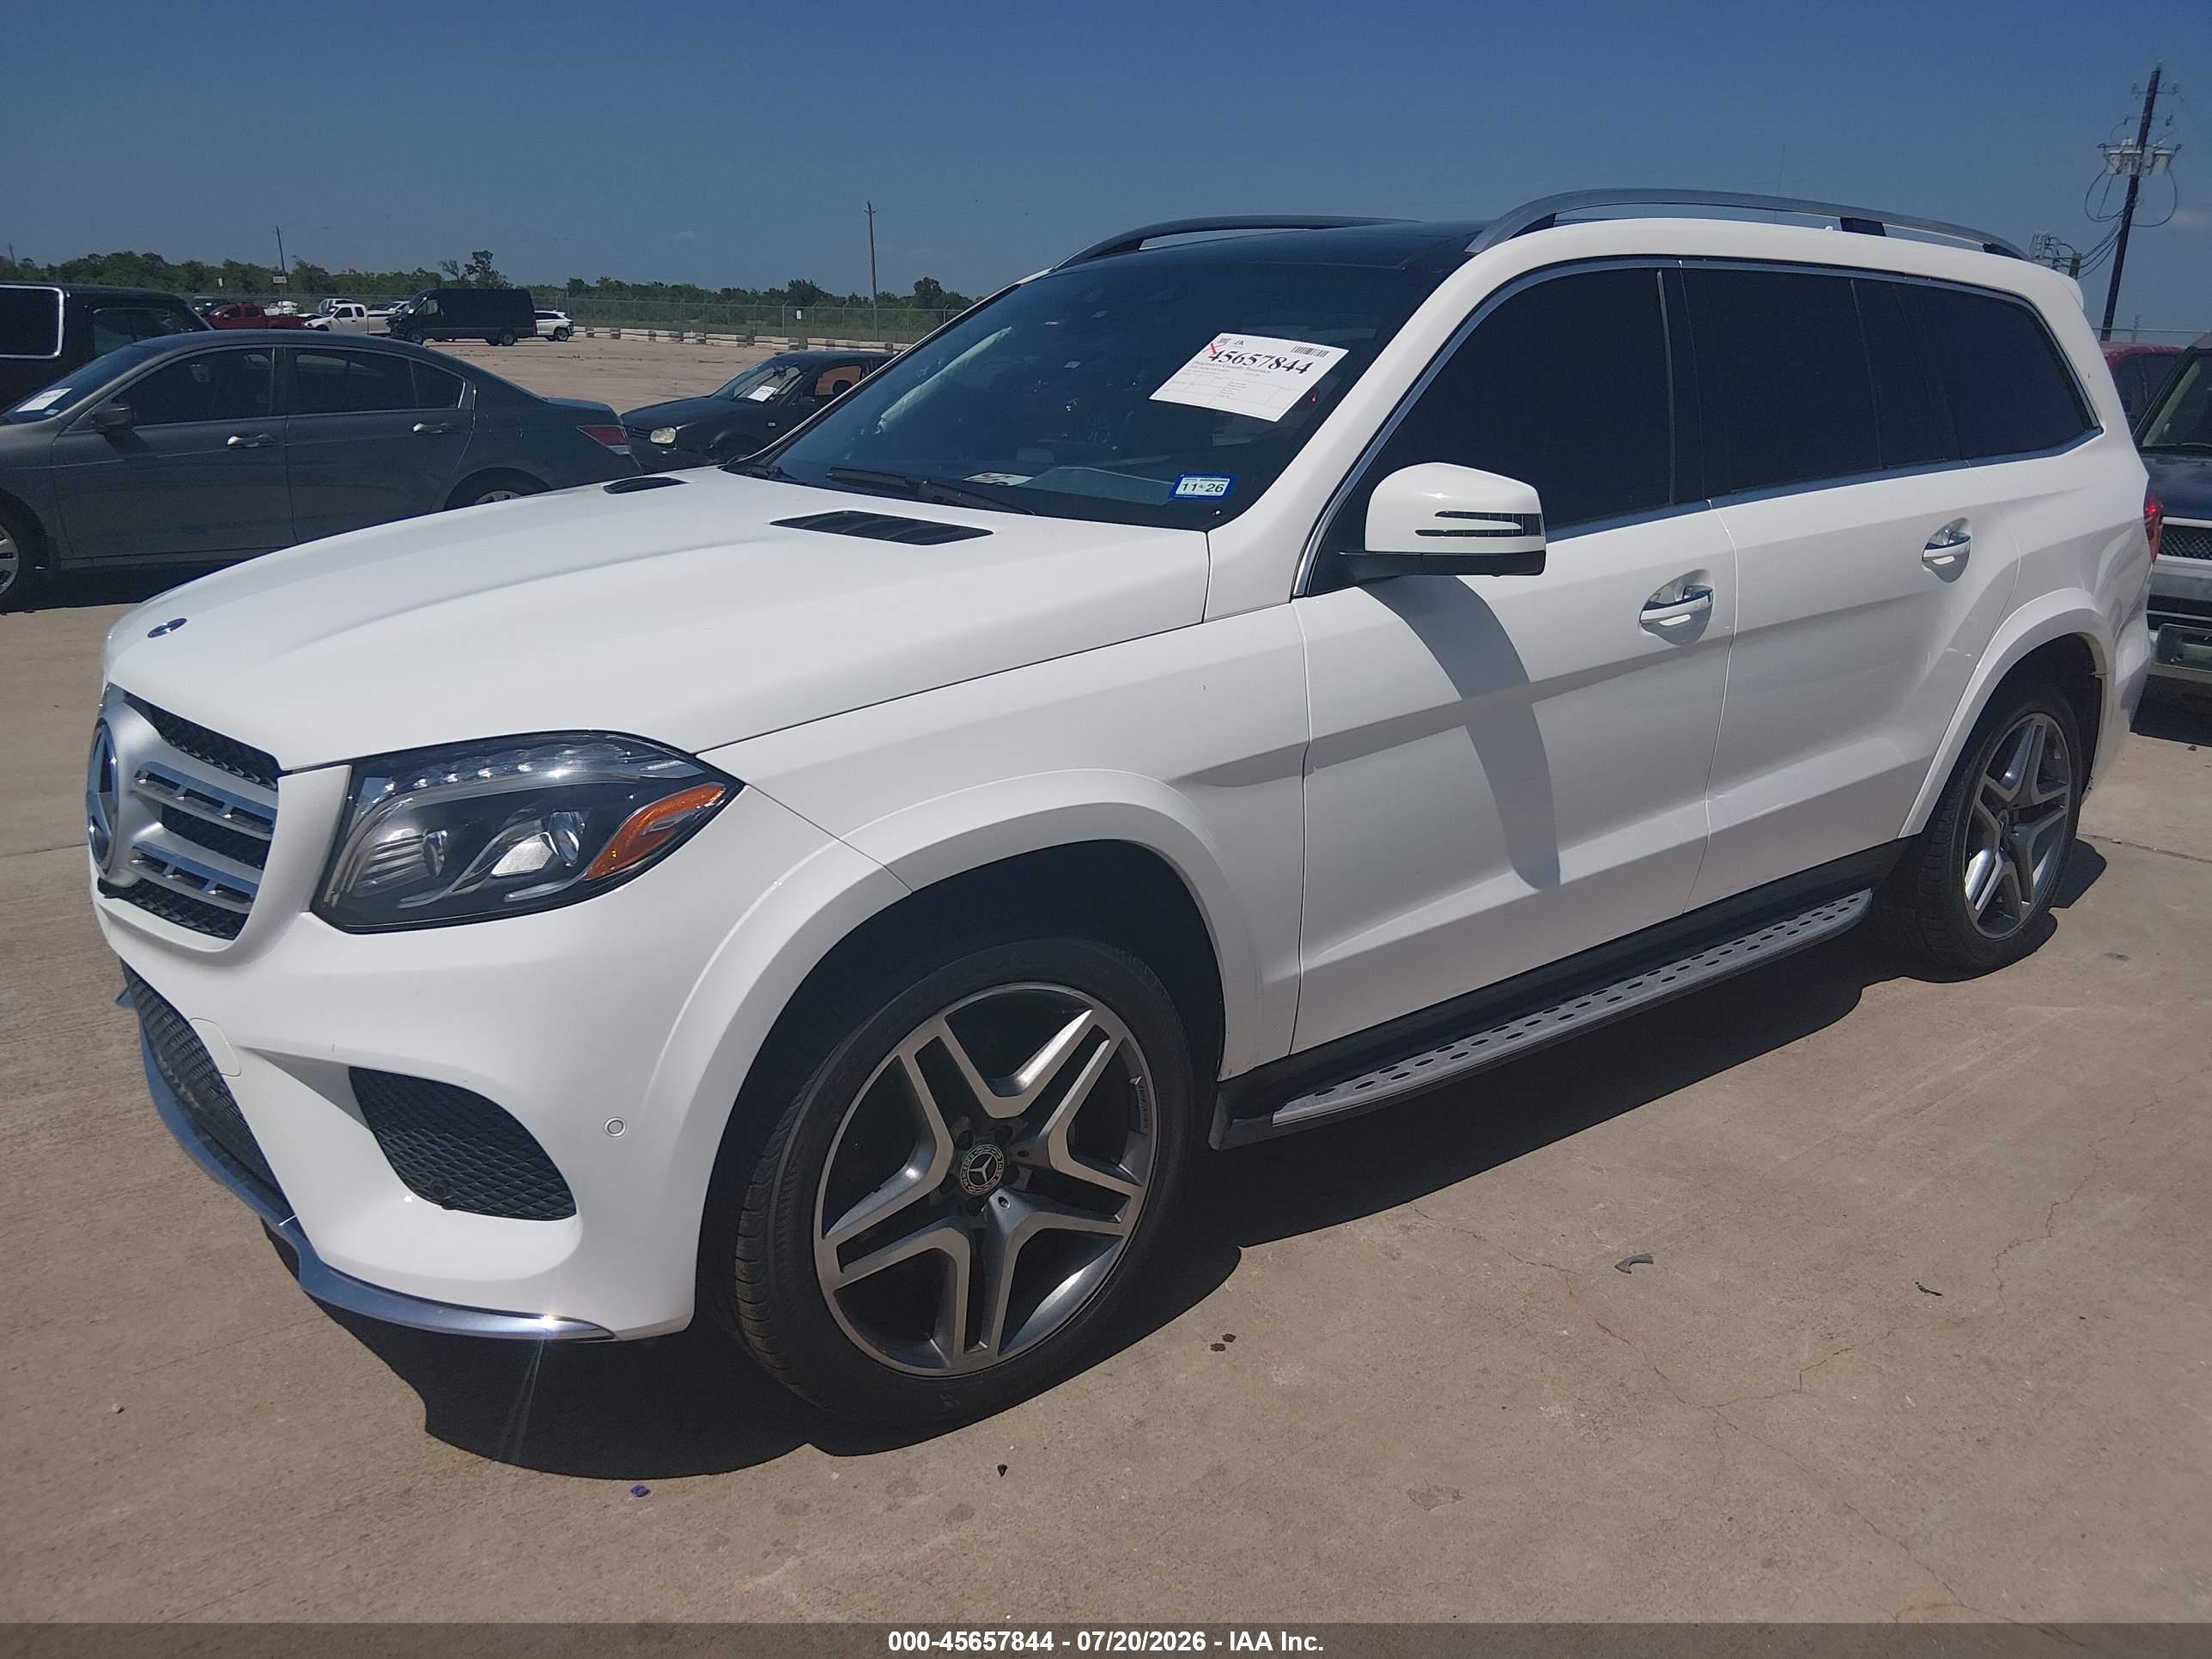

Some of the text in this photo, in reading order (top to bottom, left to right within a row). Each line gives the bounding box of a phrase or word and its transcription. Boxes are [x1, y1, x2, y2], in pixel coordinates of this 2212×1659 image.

[1208, 349, 1314, 374] 45657844
[1182, 483, 1224, 493] 11 26
